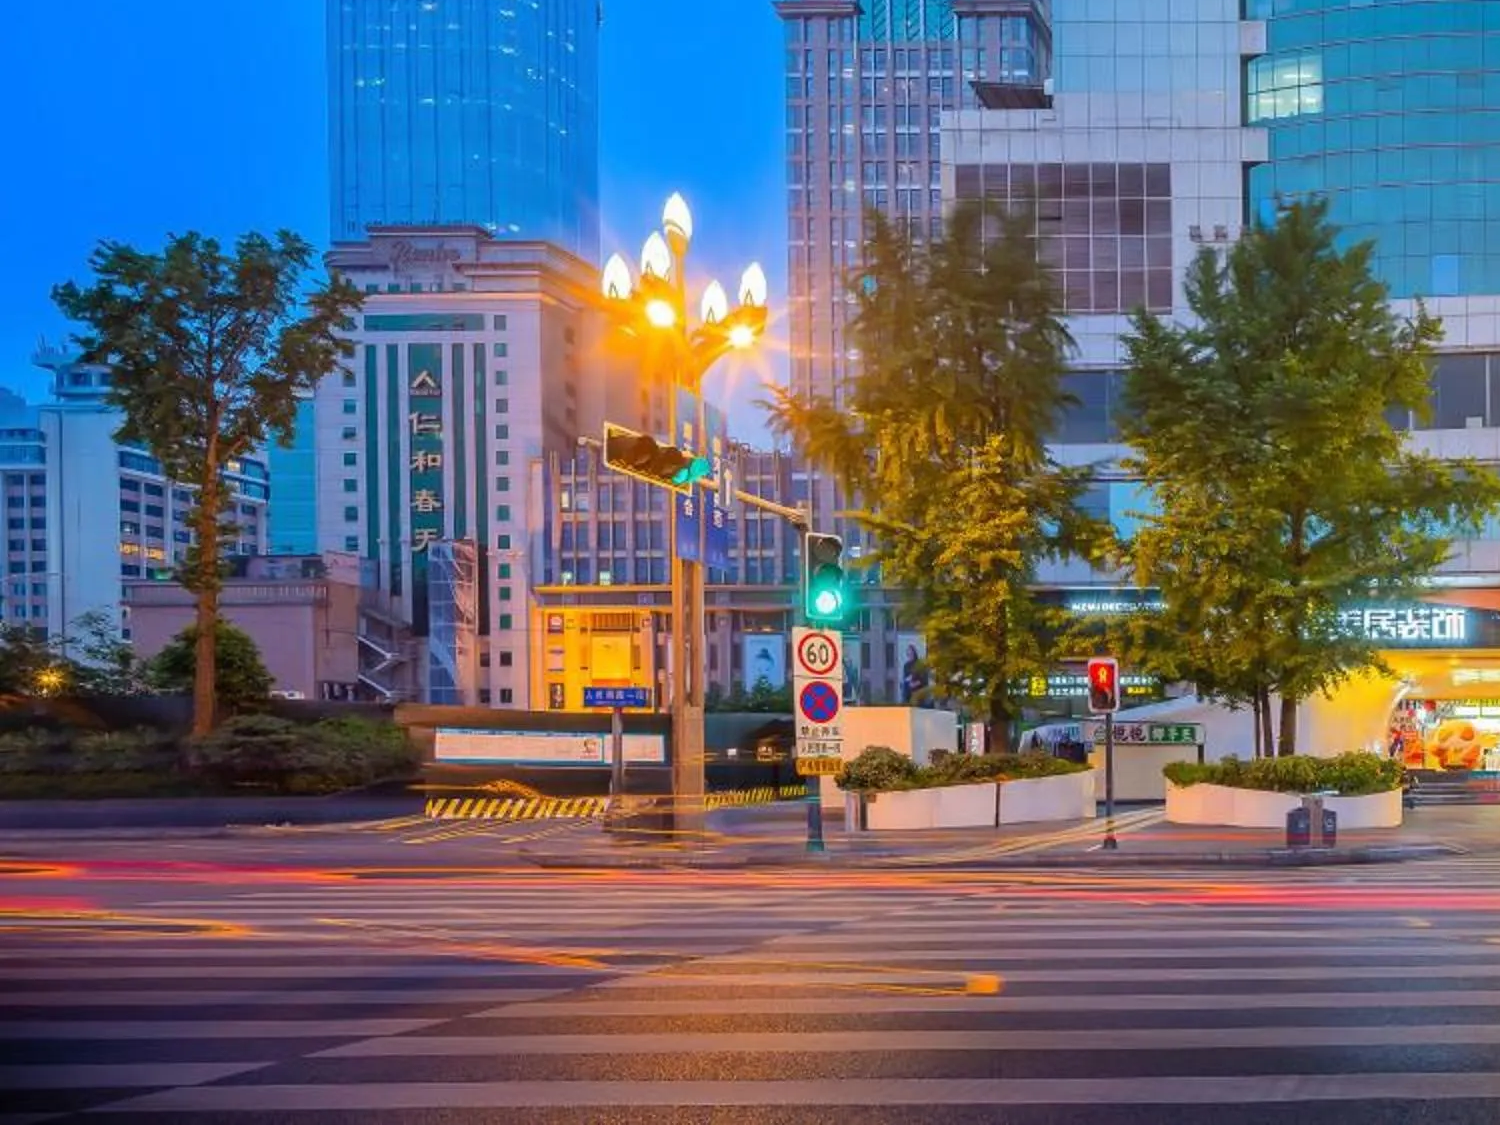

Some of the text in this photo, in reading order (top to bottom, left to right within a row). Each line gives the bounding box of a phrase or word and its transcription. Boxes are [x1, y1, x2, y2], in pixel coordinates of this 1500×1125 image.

[409, 411, 442, 552] 仁和春天
[1303, 608, 1466, 640] 居装饰
[807, 643, 829, 665] 60
